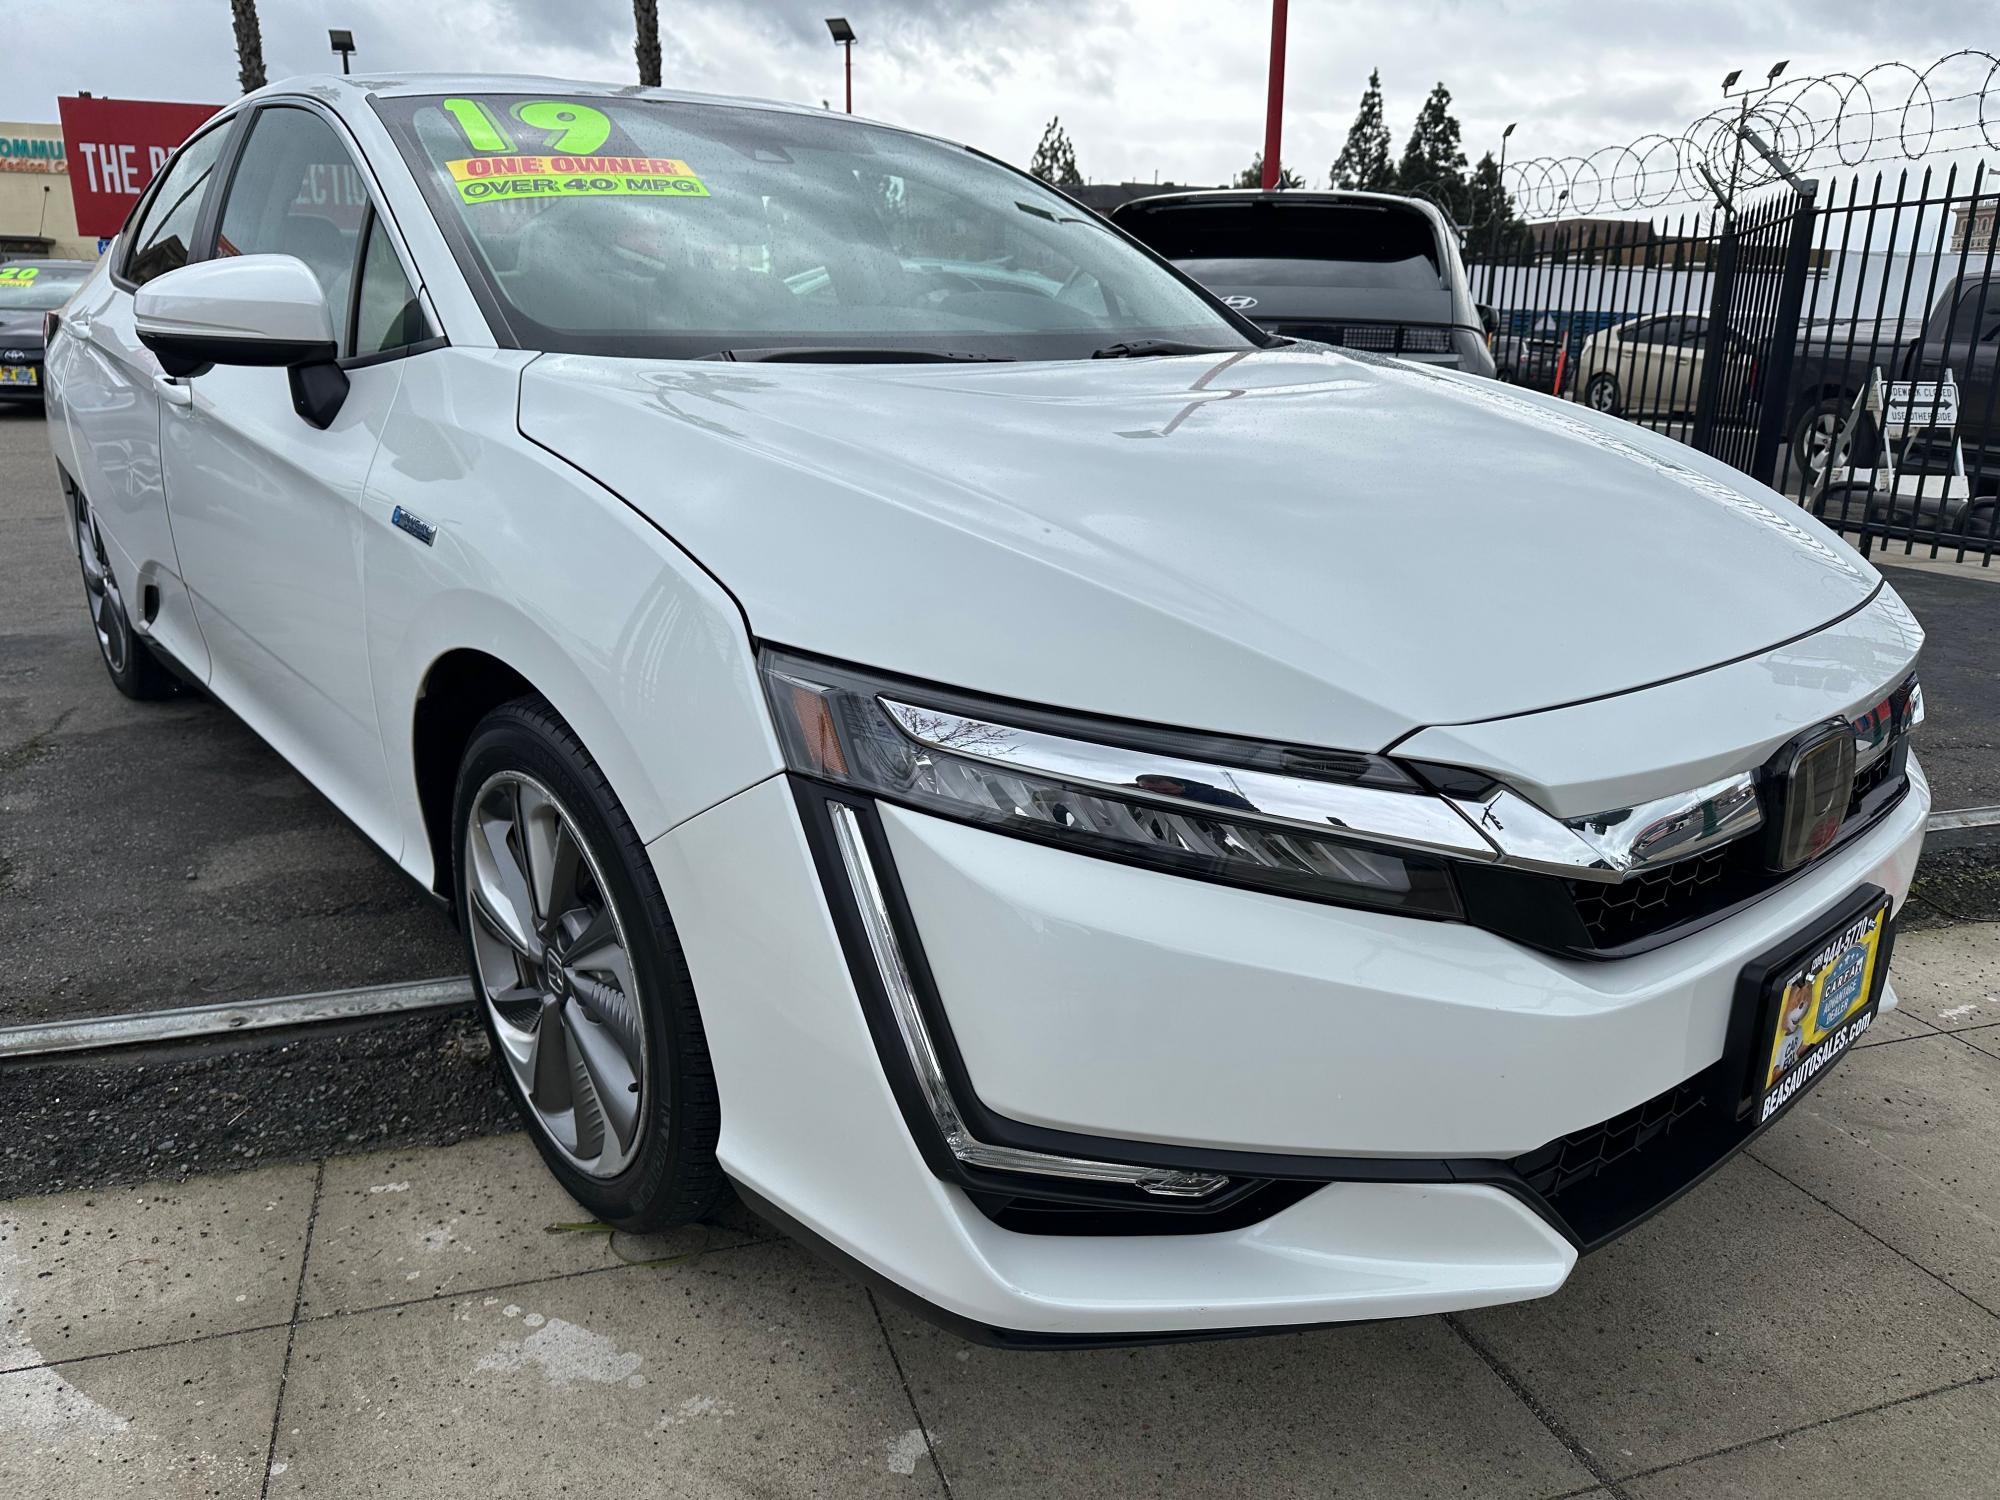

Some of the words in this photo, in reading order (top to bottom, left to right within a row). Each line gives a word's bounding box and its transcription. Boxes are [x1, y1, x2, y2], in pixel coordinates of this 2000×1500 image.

[444, 99, 611, 155] 19
[79, 143, 141, 194] THE
[467, 158, 545, 176] ONE
[551, 158, 676, 175] OWNER
[464, 179, 559, 197] OVER
[564, 178, 617, 192] 40
[627, 178, 700, 194] MPG
[1892, 411, 1905, 421] USE
[1822, 916, 1868, 970] 944-5770
[1826, 998, 1849, 1024] DEALER
[1761, 1011, 1872, 1122] BEASAUTOSALES.com
